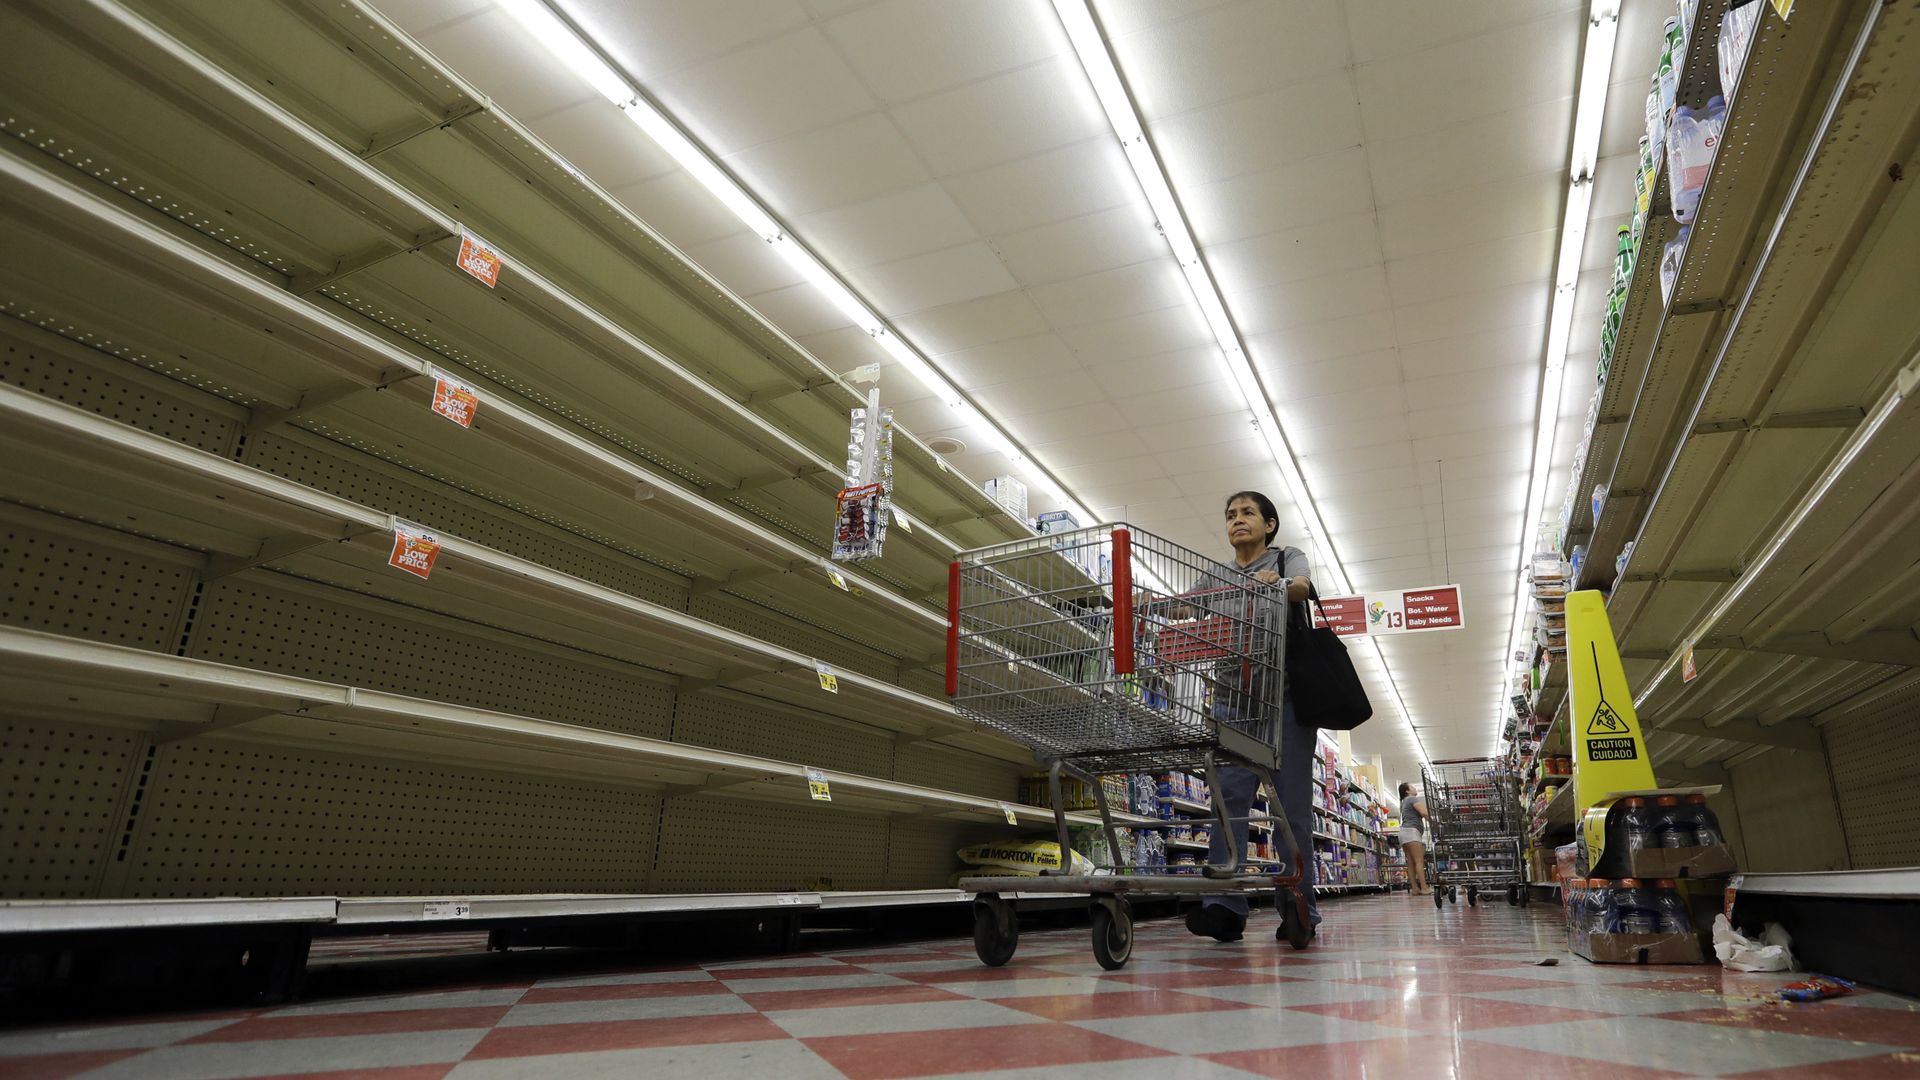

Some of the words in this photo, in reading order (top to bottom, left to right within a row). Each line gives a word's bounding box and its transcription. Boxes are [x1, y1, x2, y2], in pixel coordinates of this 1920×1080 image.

[444, 395, 467, 410] LOW
[440, 401, 468, 419] PRICE
[404, 548, 429, 561] LOW
[398, 554, 429, 570] PRICE
[1406, 595, 1434, 603] Snacks
[1314, 603, 1343, 611] Frmula
[1386, 611, 1403, 628] 13
[1429, 616, 1452, 624] Needs
[1590, 739, 1631, 749] CAUTION
[1592, 749, 1633, 760] CUIDADO
[990, 847, 1036, 862] MORTON
[1037, 857, 1058, 866] Pellets
